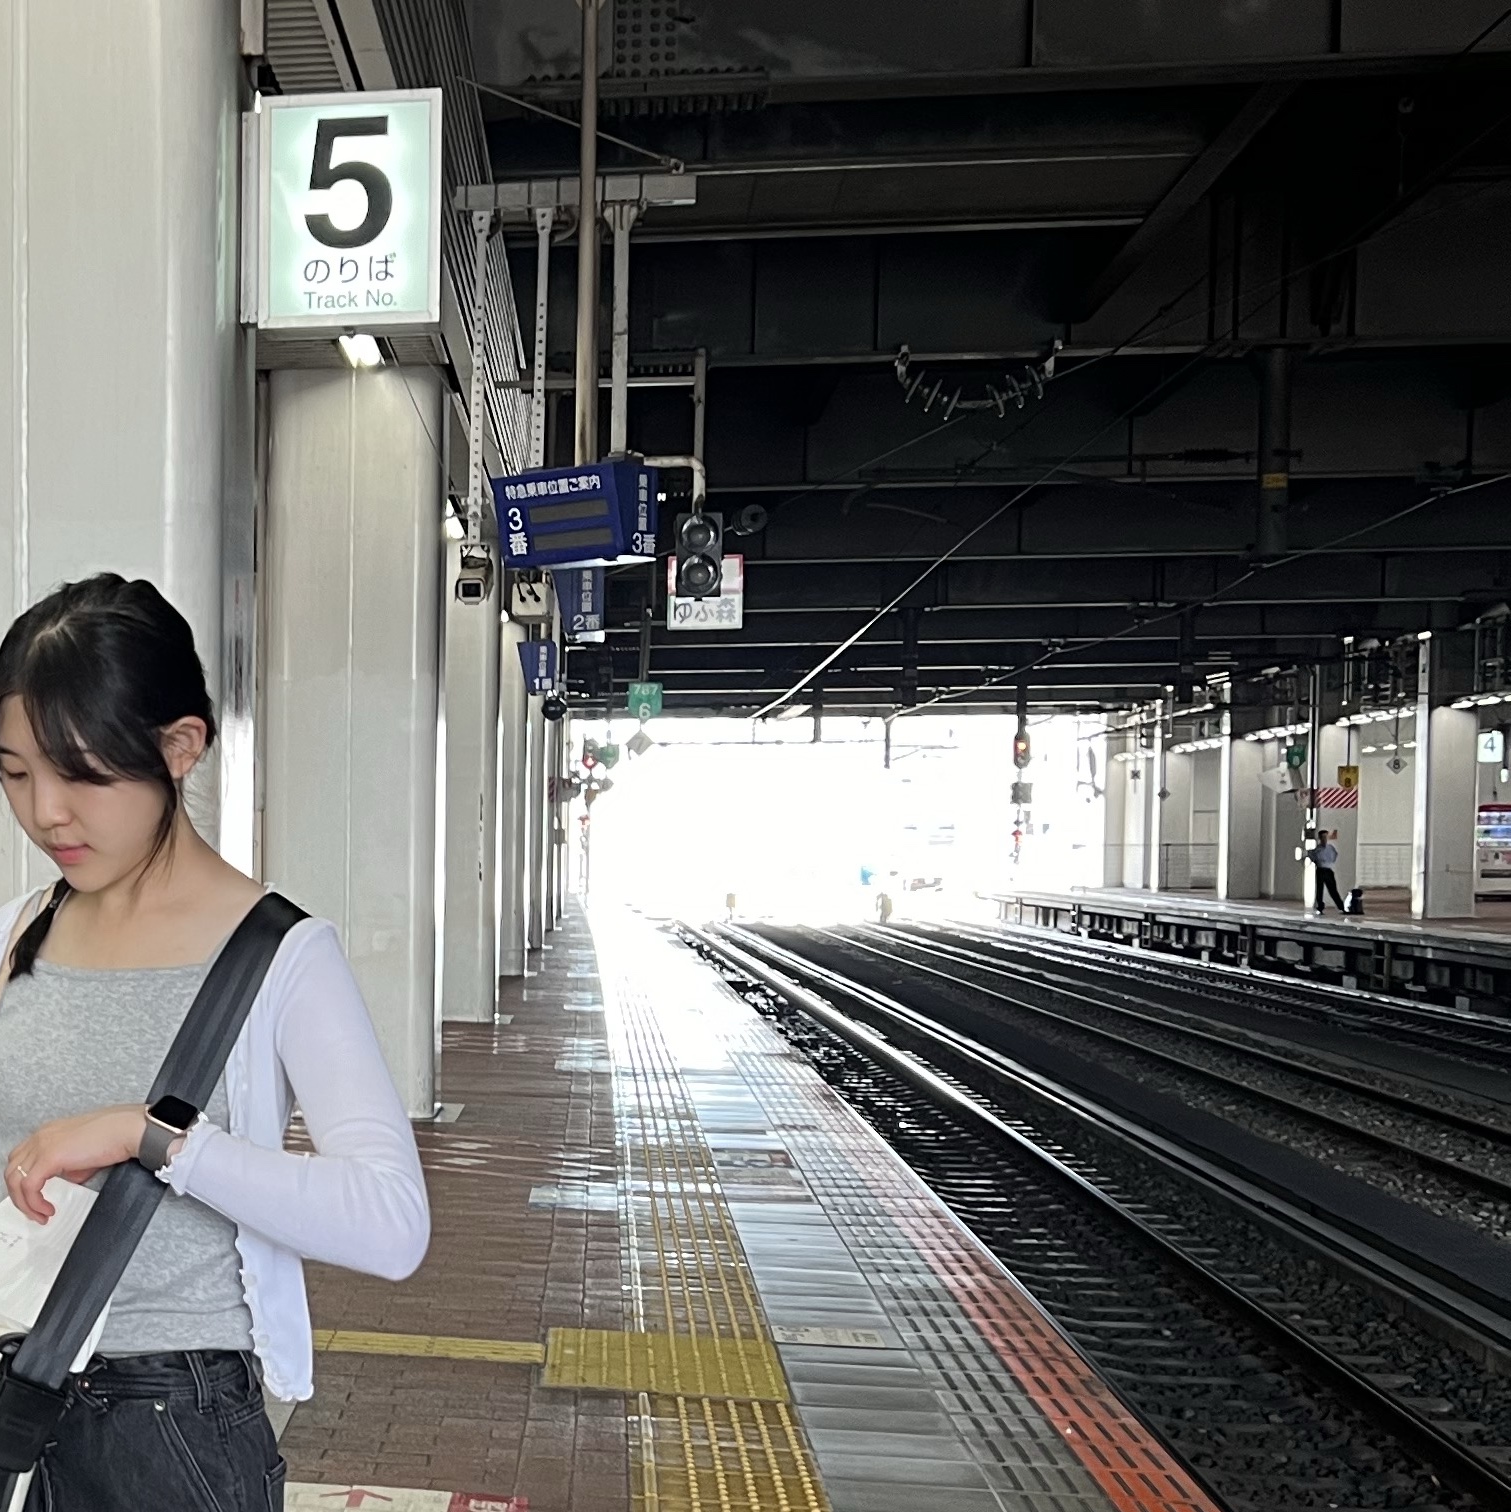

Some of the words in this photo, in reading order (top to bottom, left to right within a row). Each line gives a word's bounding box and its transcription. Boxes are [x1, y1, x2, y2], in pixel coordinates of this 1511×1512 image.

[304, 115, 393, 249] 5
[303, 252, 397, 284] のりば
[303, 290, 359, 309] Track
[365, 289, 398, 307] No.
[507, 507, 528, 556] 3番
[638, 703, 651, 719] 6
[1483, 737, 1496, 753] 4
